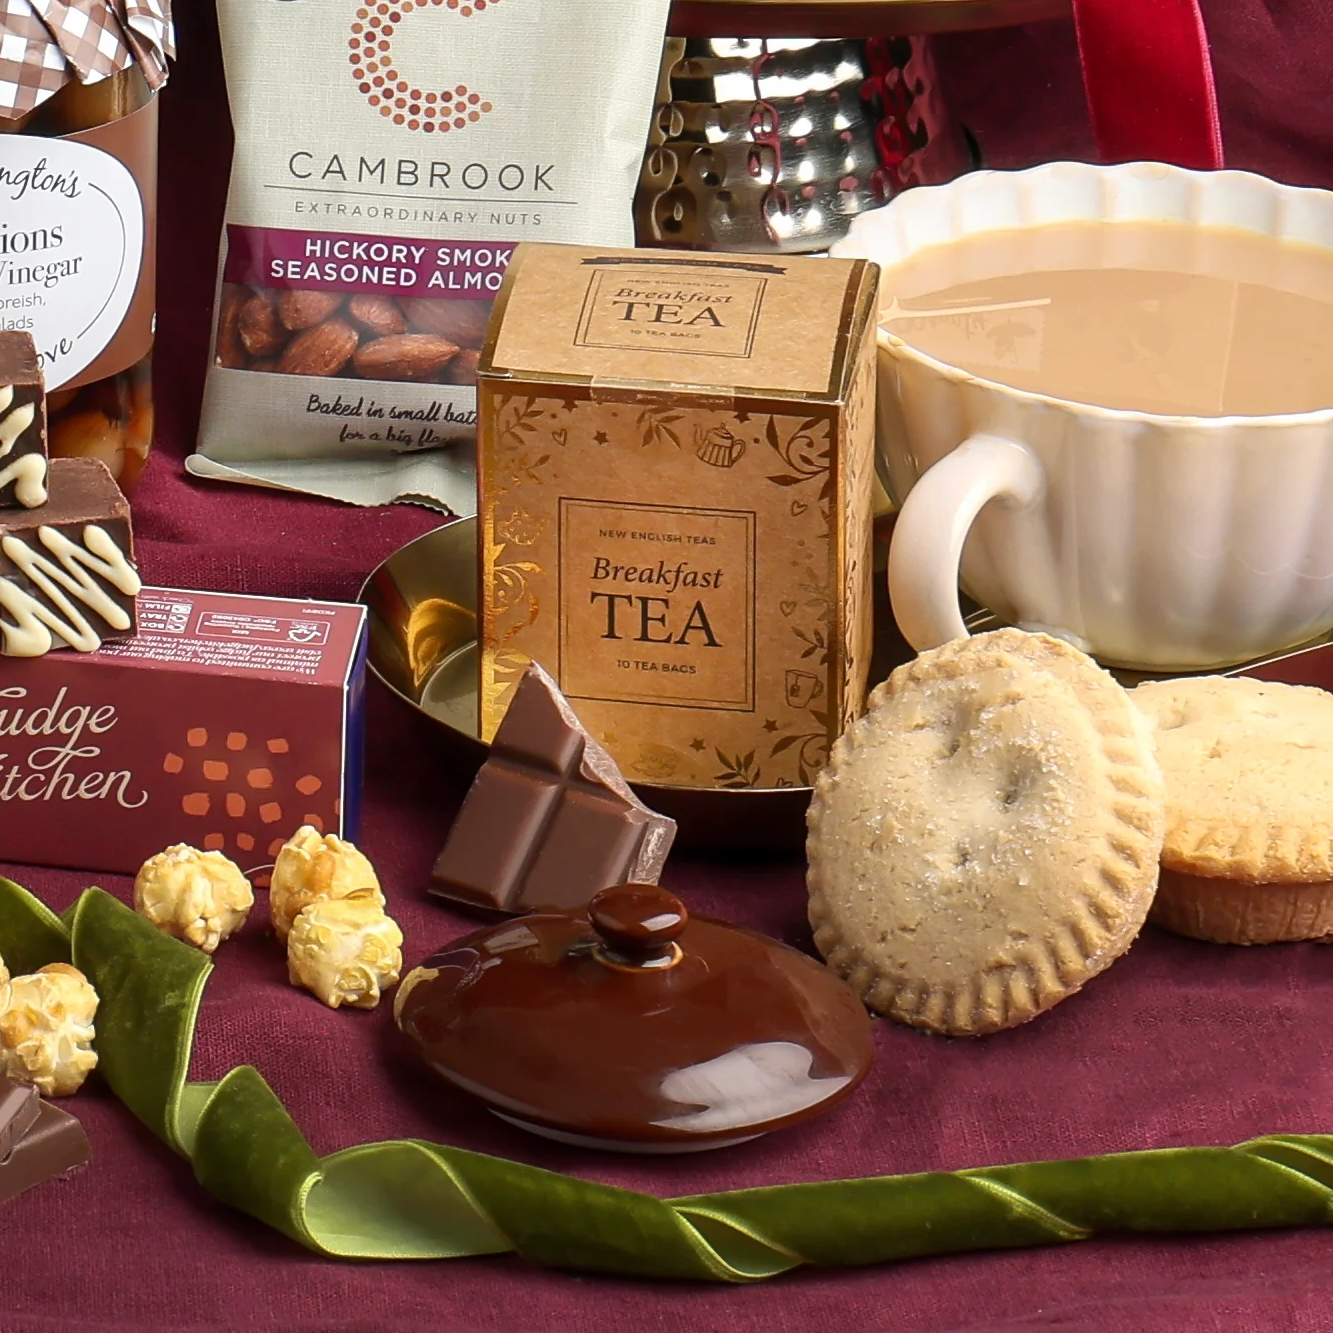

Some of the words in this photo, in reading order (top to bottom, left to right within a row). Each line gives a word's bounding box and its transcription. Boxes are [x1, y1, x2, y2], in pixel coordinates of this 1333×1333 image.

[288, 150, 555, 192] CAMBROOK
[295, 200, 478, 224] EXTRAORDINARY
[489, 213, 542, 226] NUTS
[304, 239, 425, 265] HICKORY
[437, 247, 511, 268] SMOK
[270, 260, 416, 286] SEASONED
[427, 268, 503, 291] ALMO
[614, 288, 733, 303] Breakfast
[612, 301, 725, 327] TEA
[599, 529, 627, 539] NEW
[631, 531, 683, 543] ENGLISH
[686, 535, 716, 545] TEAS
[591, 556, 724, 593] Breakfast
[590, 592, 723, 648] TEA
[617, 659, 630, 670] 10
[634, 660, 658, 672] TEA
[661, 663, 696, 674] BAGS
